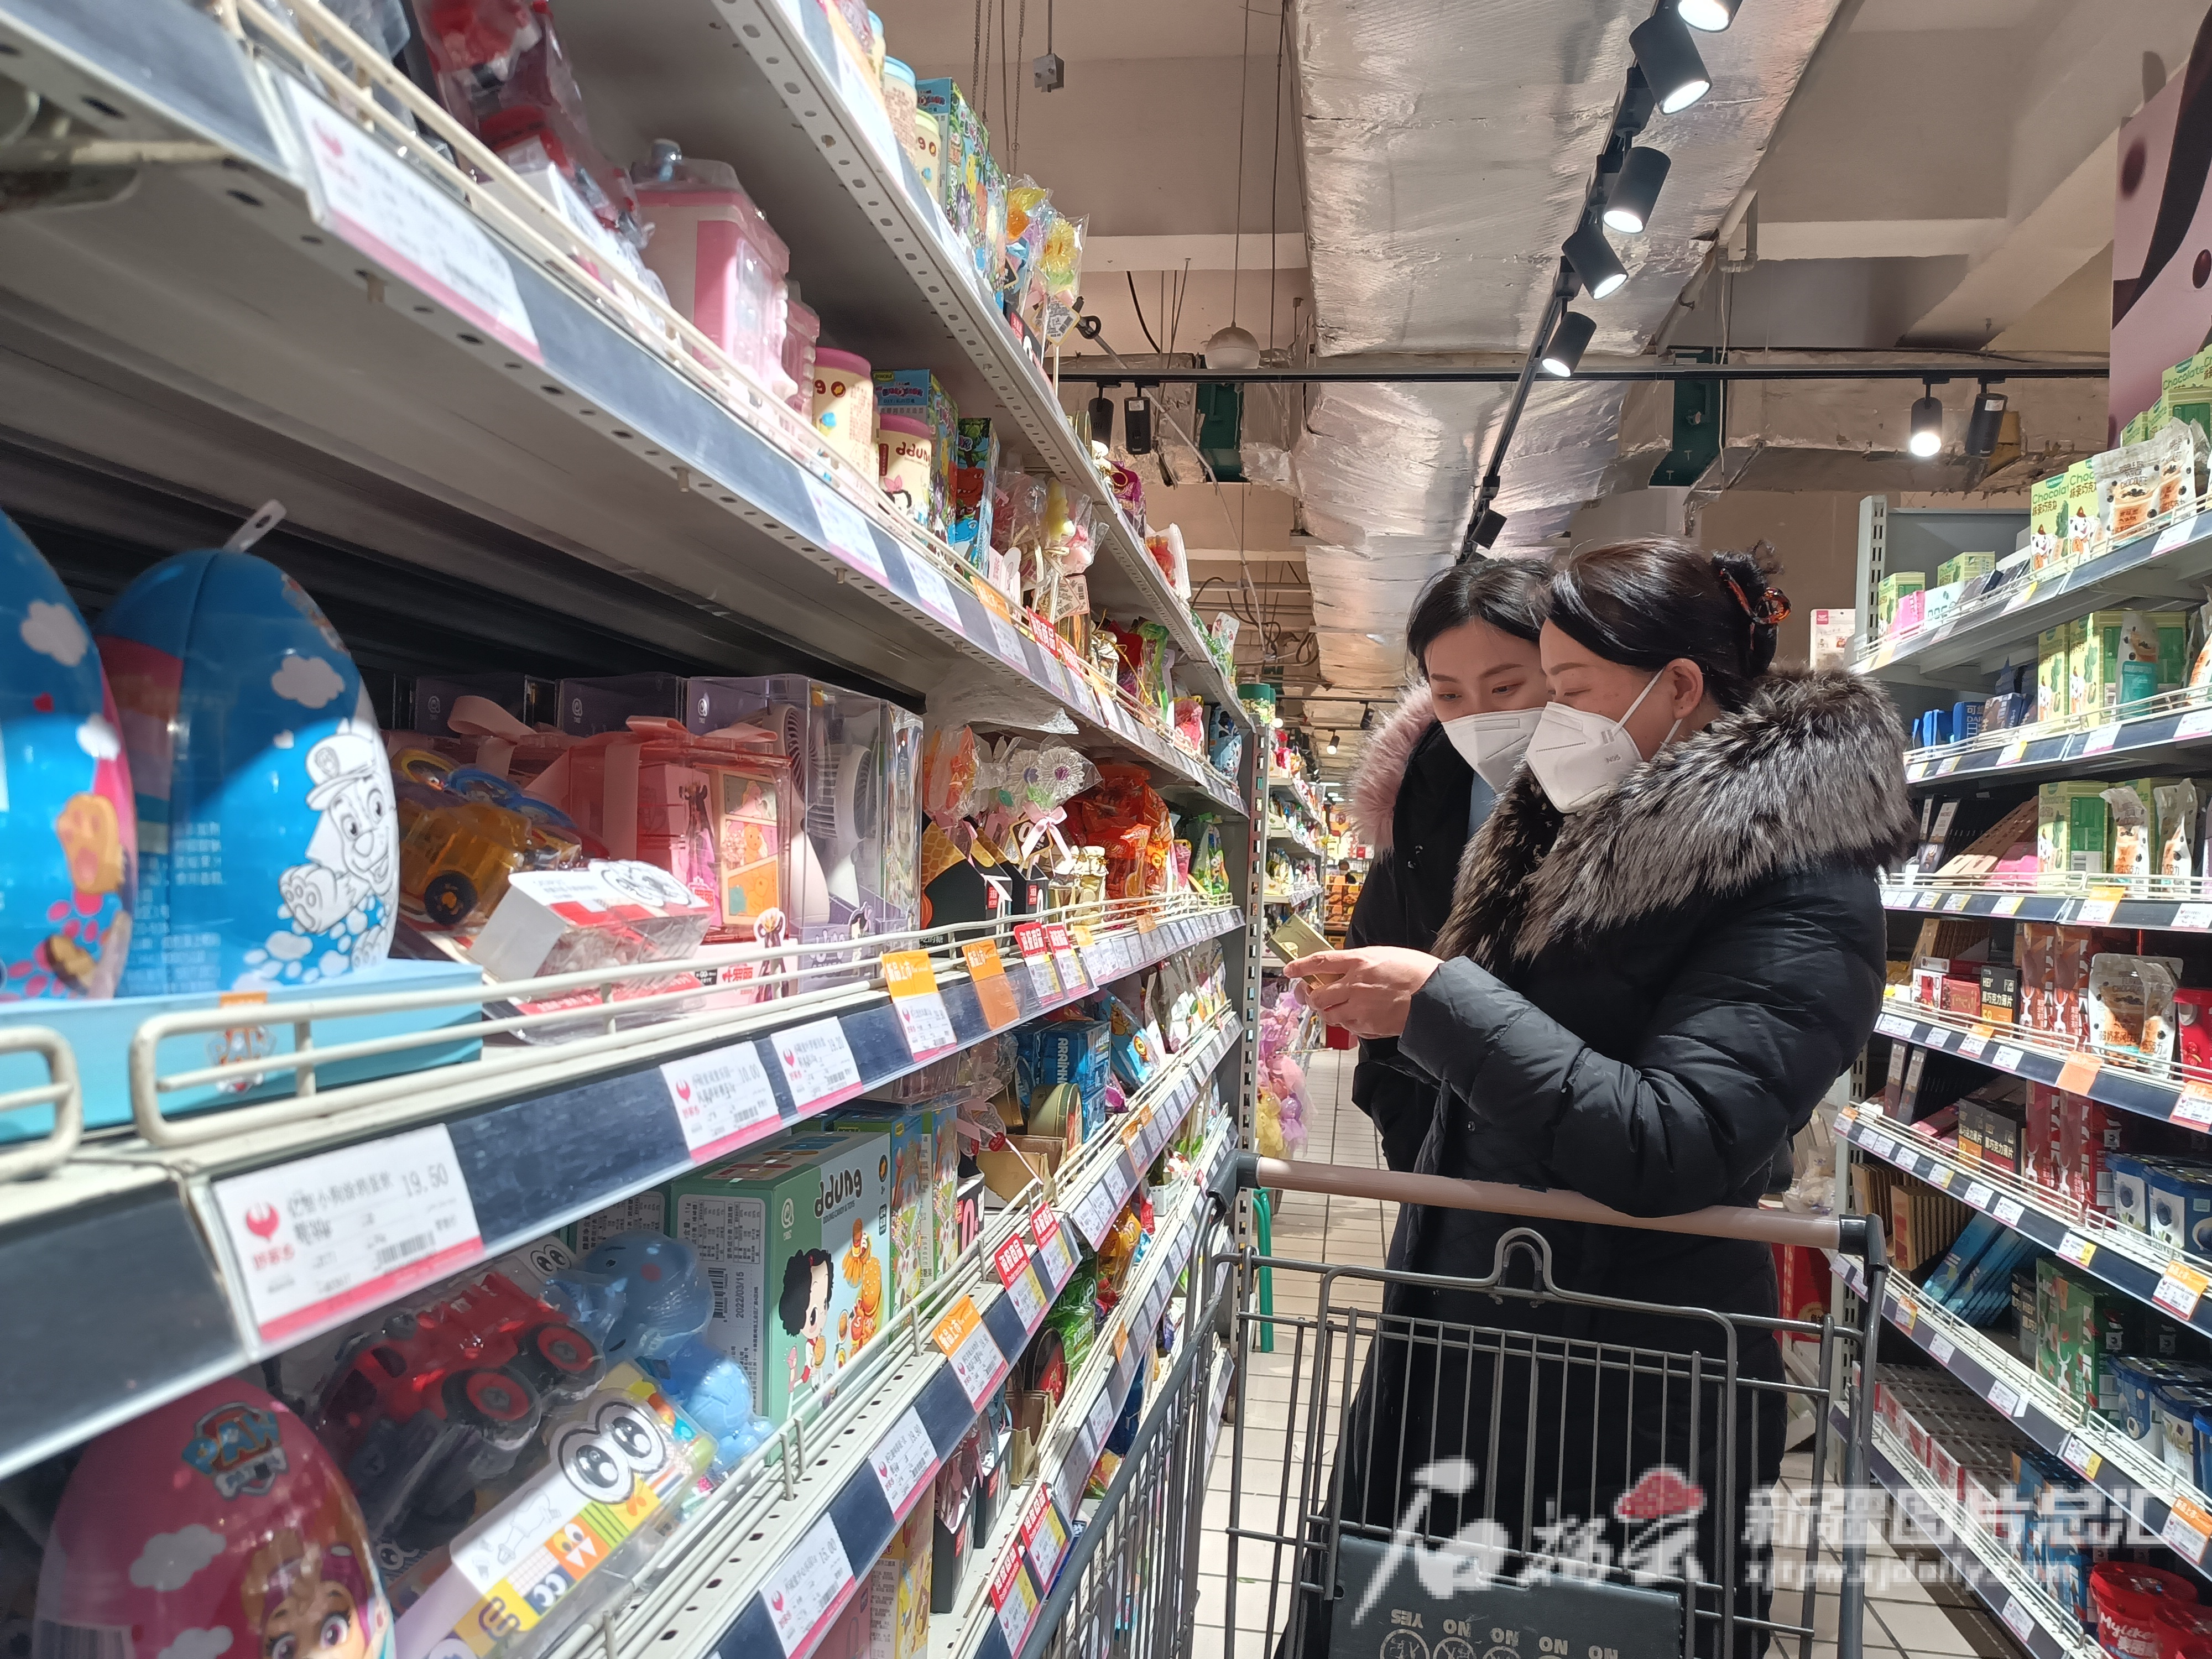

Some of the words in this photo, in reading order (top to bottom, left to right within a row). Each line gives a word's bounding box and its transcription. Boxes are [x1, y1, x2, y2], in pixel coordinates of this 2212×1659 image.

[1019, 927, 1044, 953] 海报商品
[401, 1162, 451, 1198] 19.50
[814, 1168, 863, 1219] ddung
[998, 1238, 1022, 1275] 海报商品
[735, 1271, 745, 1319] 2022/03/15
[937, 1318, 963, 1351] 新品上市
[1390, 1608, 1425, 1629] YES
[1442, 1618, 1472, 1638] NO
[1490, 1627, 1520, 1647] NO
[1538, 1636, 1569, 1655] NO
[1588, 1645, 1619, 1659] NO
